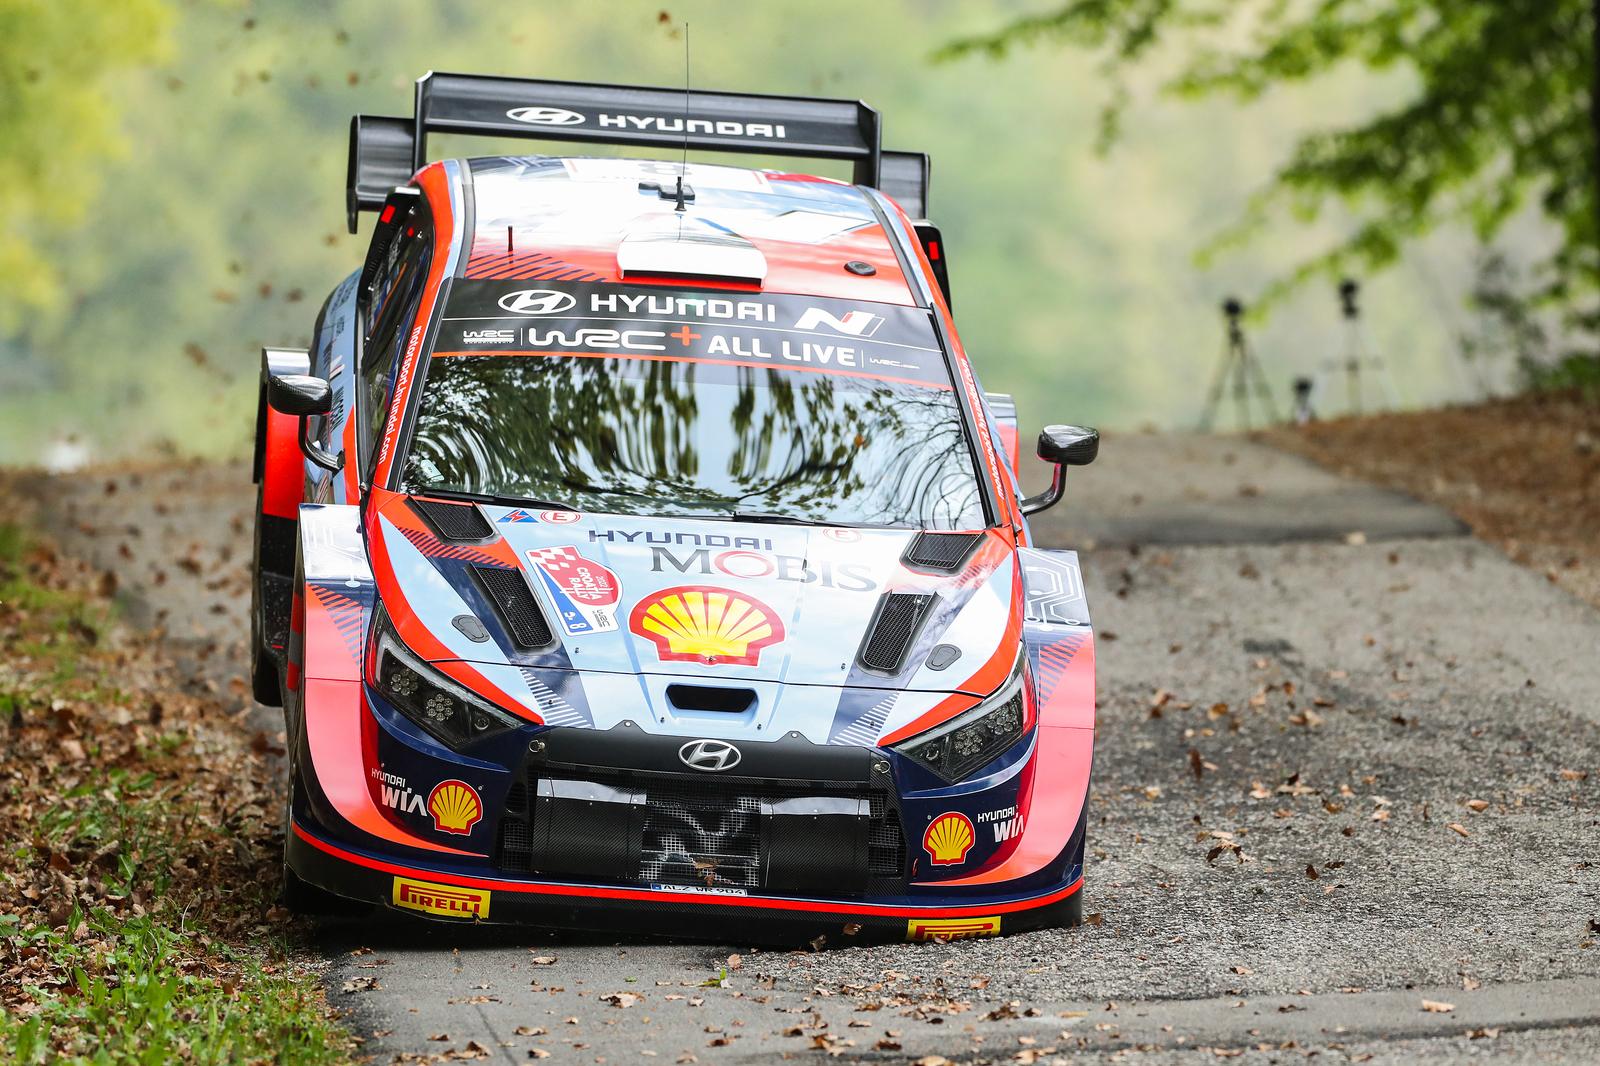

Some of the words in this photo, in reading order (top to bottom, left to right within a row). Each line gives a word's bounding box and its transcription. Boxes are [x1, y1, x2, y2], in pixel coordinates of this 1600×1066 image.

[599, 114, 786, 138] HYUNDAI
[591, 294, 776, 322] HYUNDAI
[707, 335, 772, 358] ALL
[782, 341, 856, 366] LIVE
[378, 325, 423, 464] motorsport.hyundai.com
[588, 530, 773, 550] HYUNDAI
[650, 546, 877, 592] MOBIS
[569, 577, 591, 600] RALLY
[576, 567, 603, 600] CROATIA
[569, 622, 587, 630] 8
[371, 767, 406, 788] HYUNDAI
[977, 806, 1015, 823] HYUNDAI
[399, 883, 483, 914] PIRELLI
